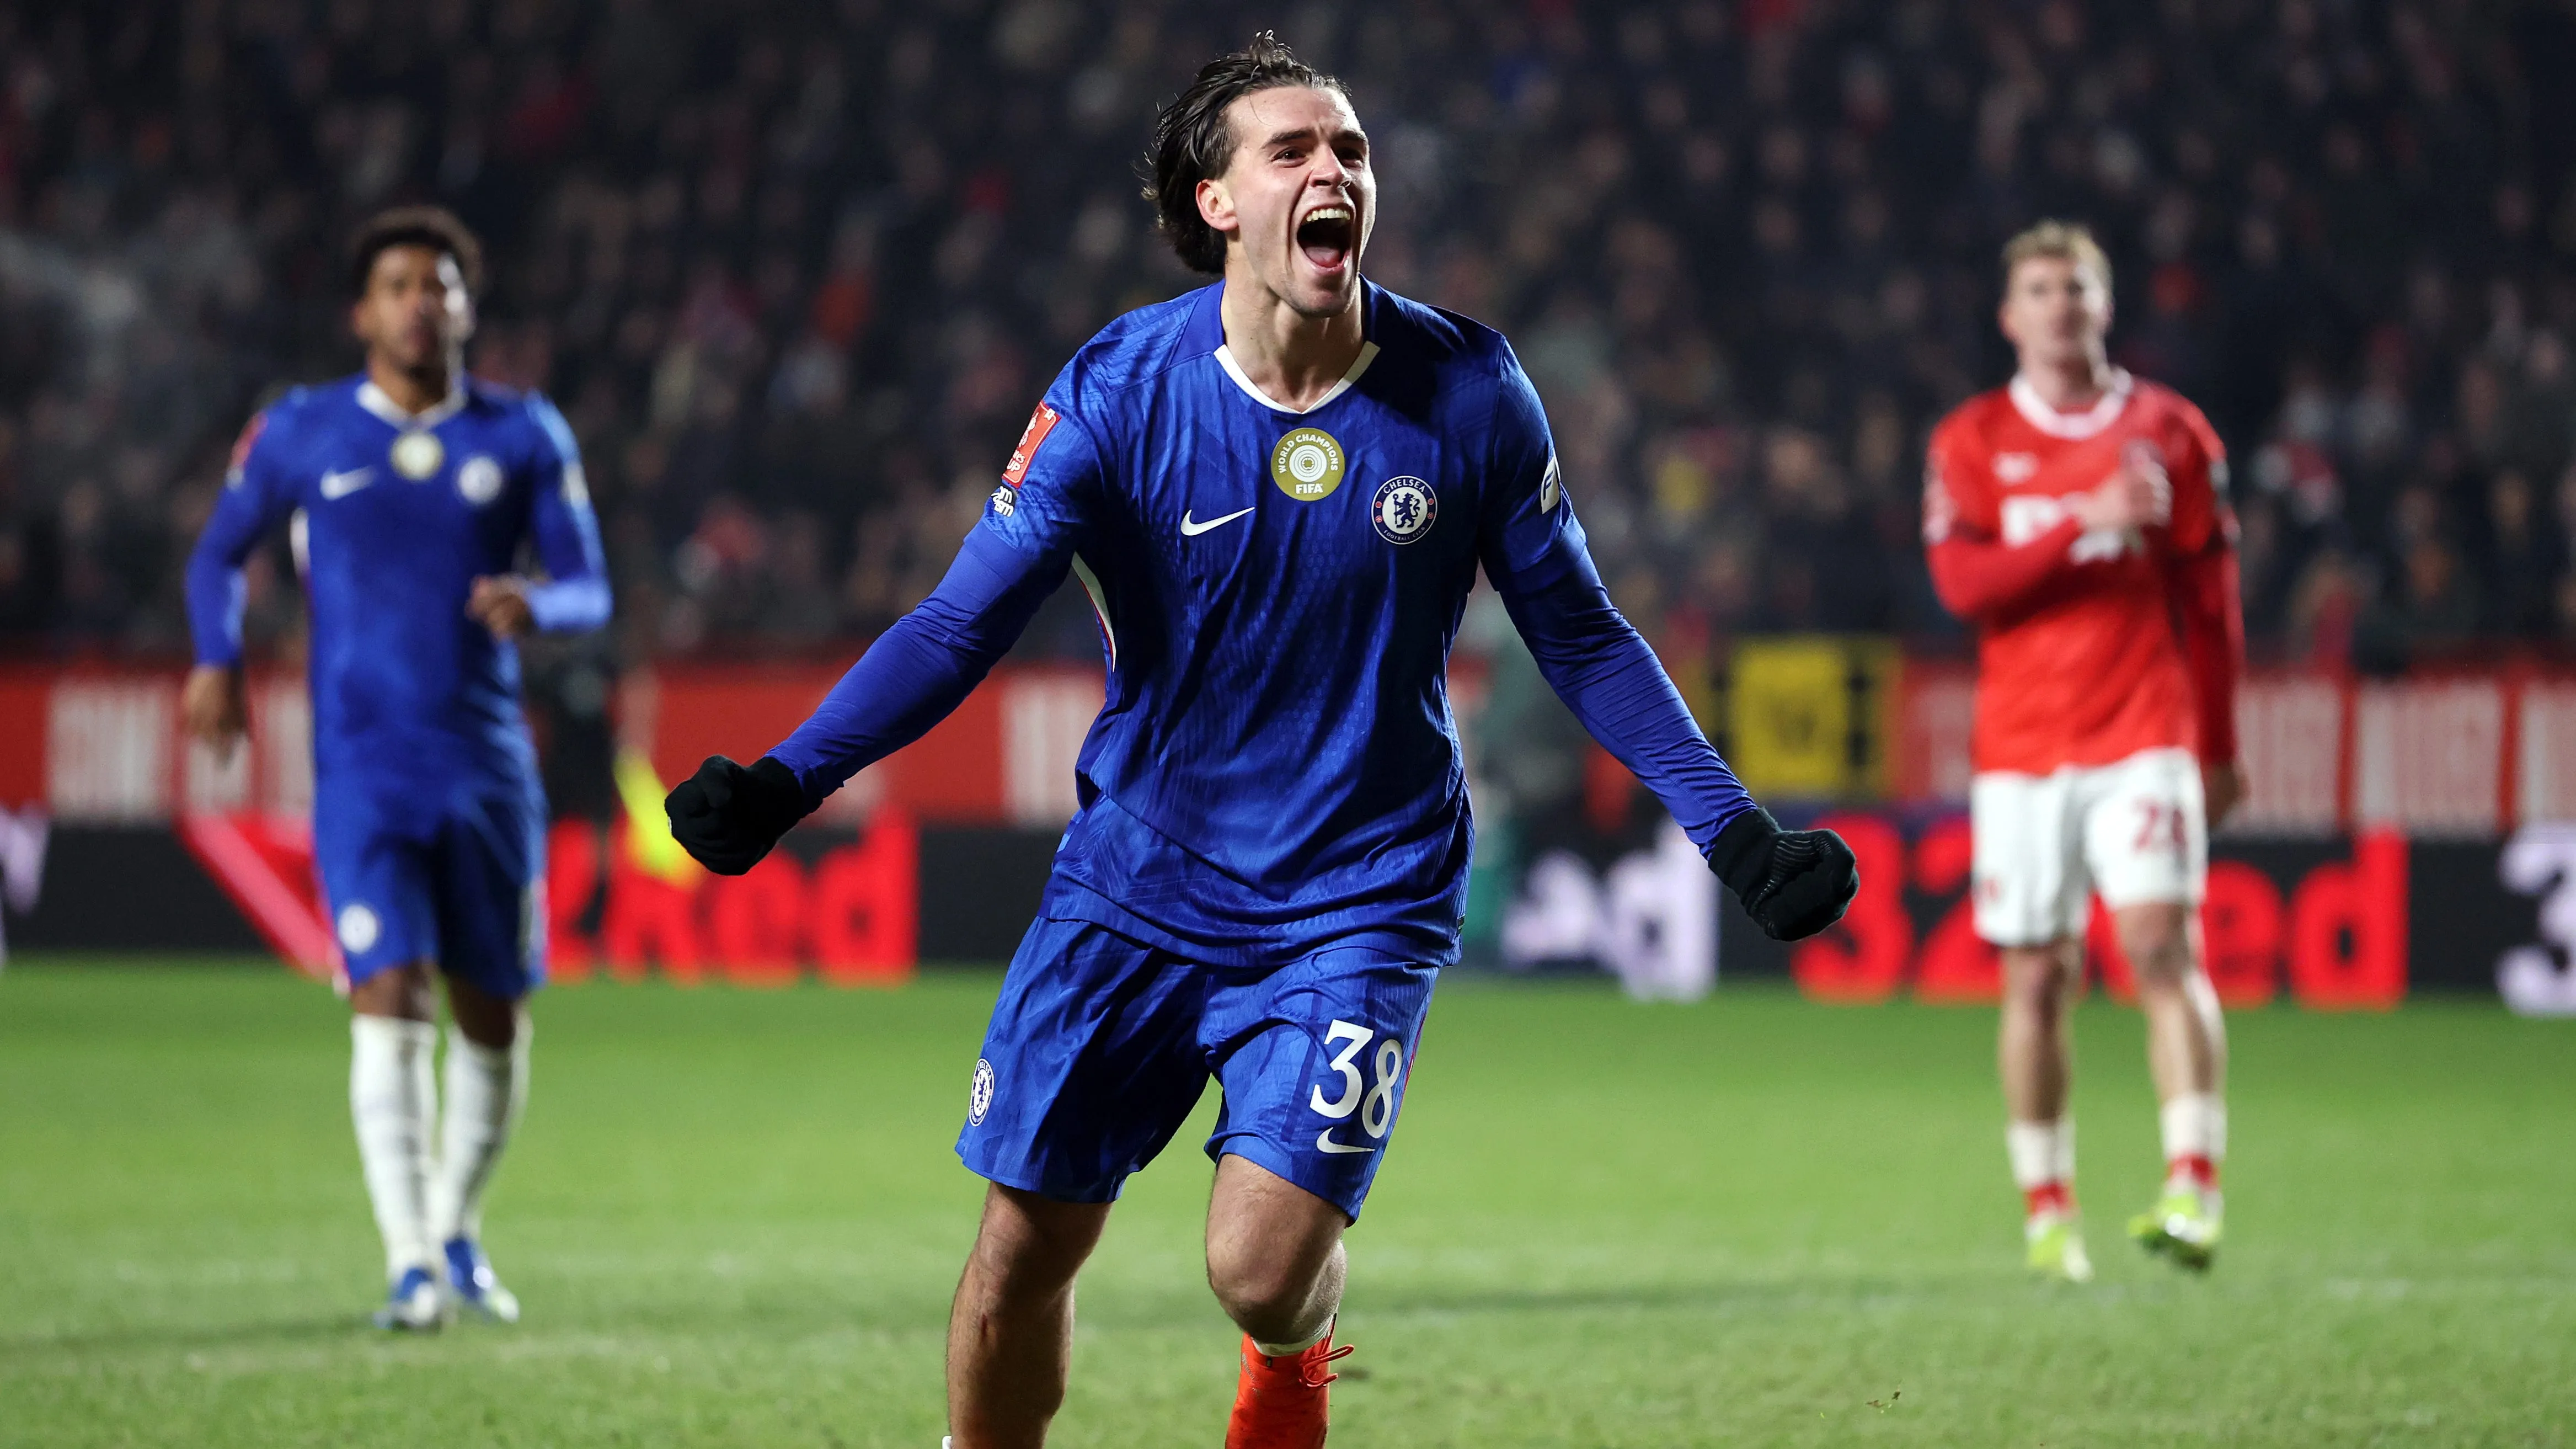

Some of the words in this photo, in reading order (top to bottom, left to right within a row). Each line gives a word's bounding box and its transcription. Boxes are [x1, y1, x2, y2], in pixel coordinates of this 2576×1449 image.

[1278, 440, 1295, 473] WORLD
[1295, 434, 1339, 471] CHAMPIONS
[1007, 459, 1021, 472] UP
[1295, 483, 1324, 494] FIFA
[1383, 478, 1426, 494] CHELSEA
[1309, 1019, 1403, 1139] 38
